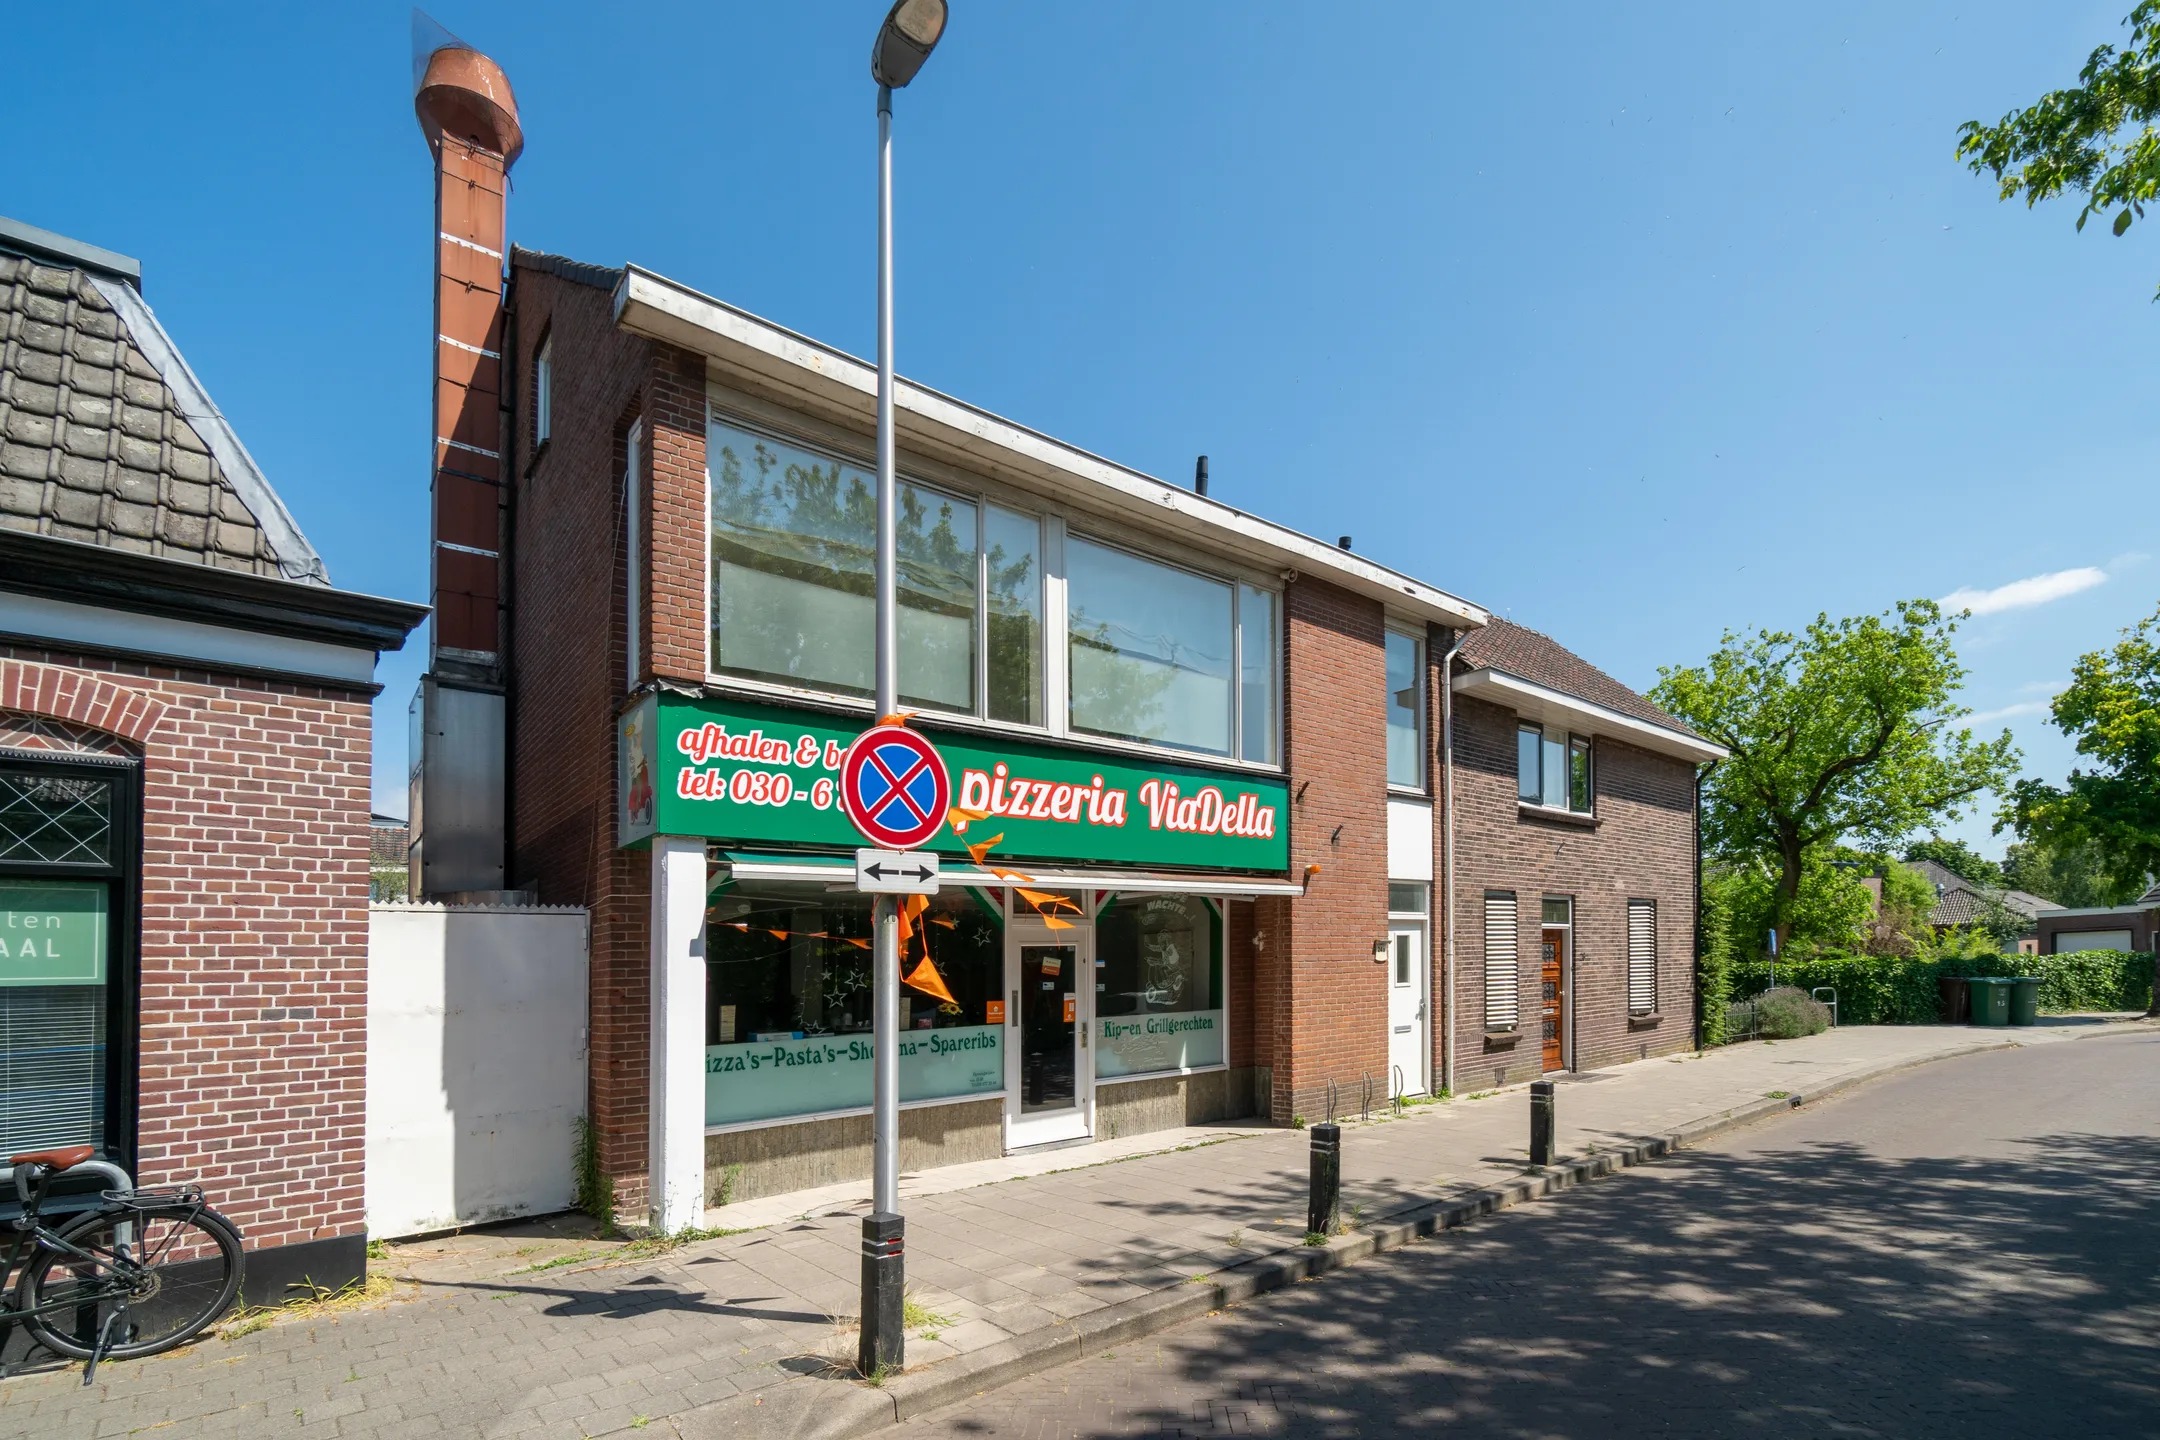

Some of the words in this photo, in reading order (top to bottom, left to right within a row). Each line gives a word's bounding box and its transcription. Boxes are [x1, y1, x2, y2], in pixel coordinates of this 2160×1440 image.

[678, 723, 791, 764] afhalen
[794, 735, 821, 767] &
[677, 768, 727, 799] tel:
[954, 762, 1128, 834] pizzeria
[1139, 779, 1275, 839] ViaDella
[1146, 1015, 1214, 1035] Grillgerechten
